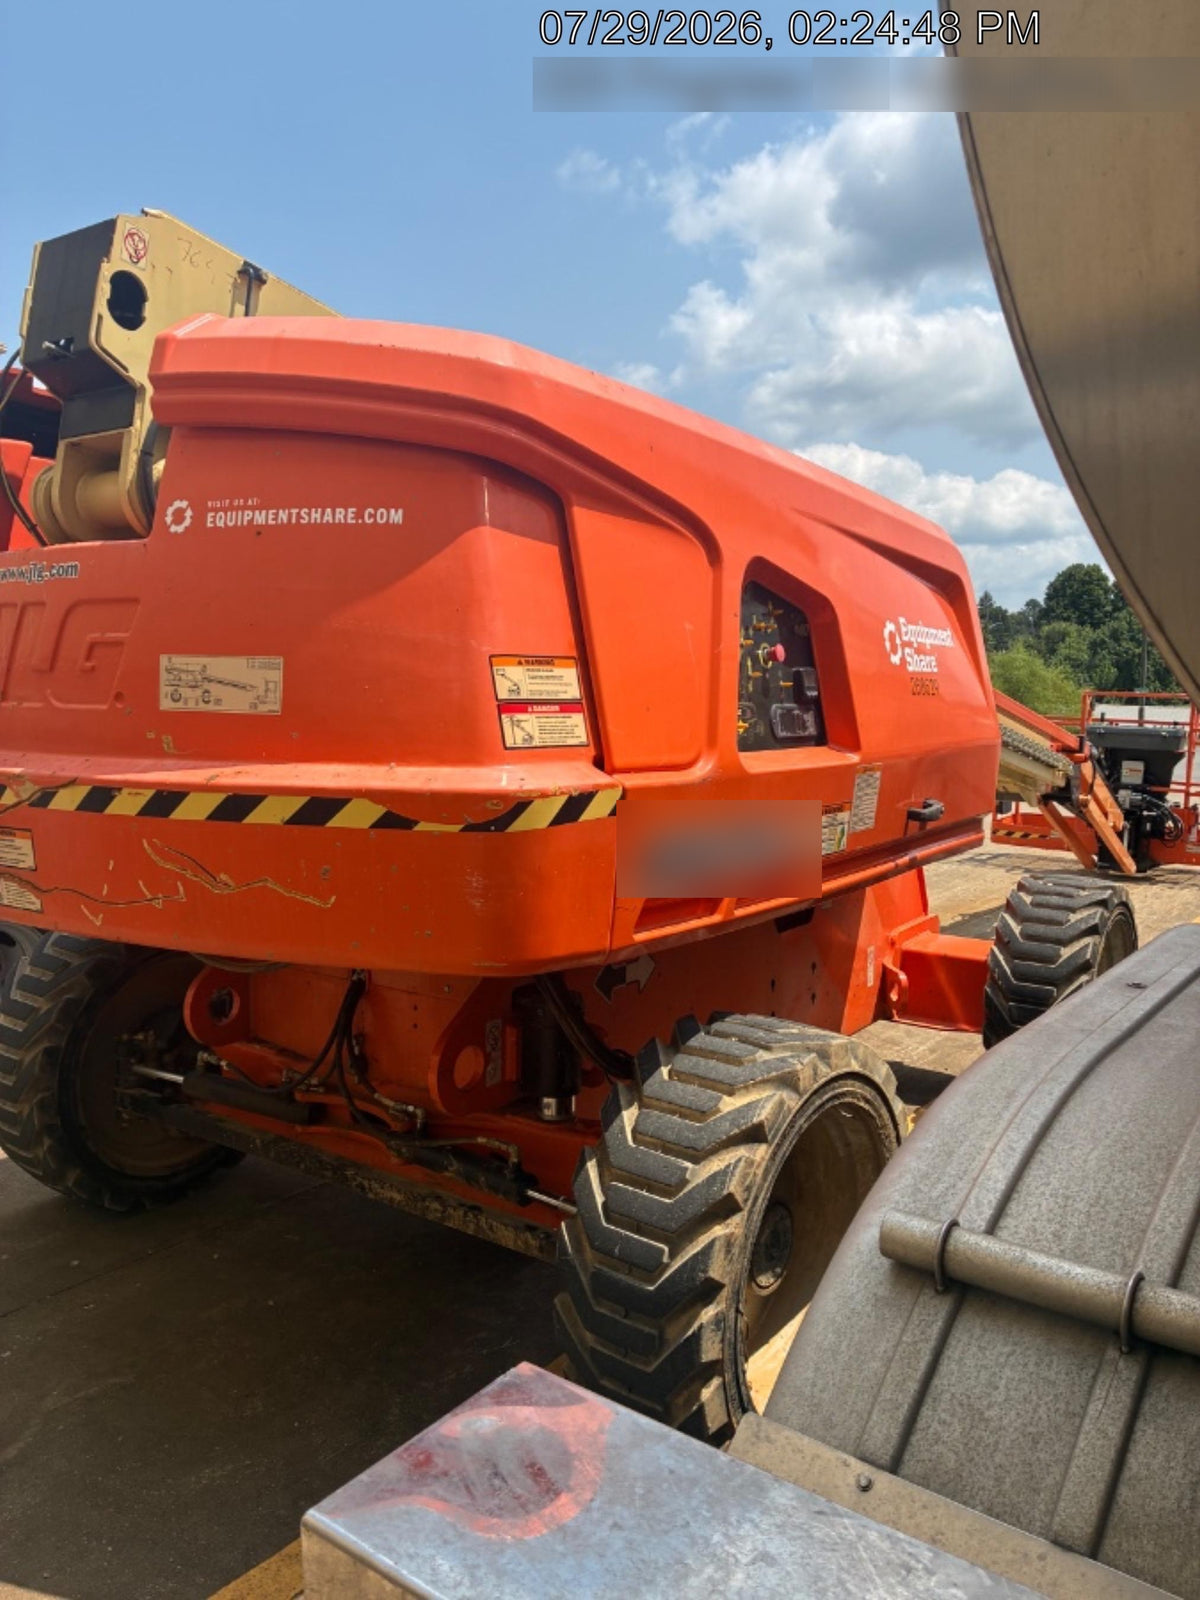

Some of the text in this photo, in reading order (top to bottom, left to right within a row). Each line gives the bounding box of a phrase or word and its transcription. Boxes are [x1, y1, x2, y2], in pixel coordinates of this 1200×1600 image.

[206, 507, 404, 528] EQUIPMENTSHARE.COM
[898, 616, 954, 648] Equipment
[904, 646, 939, 672] Share
